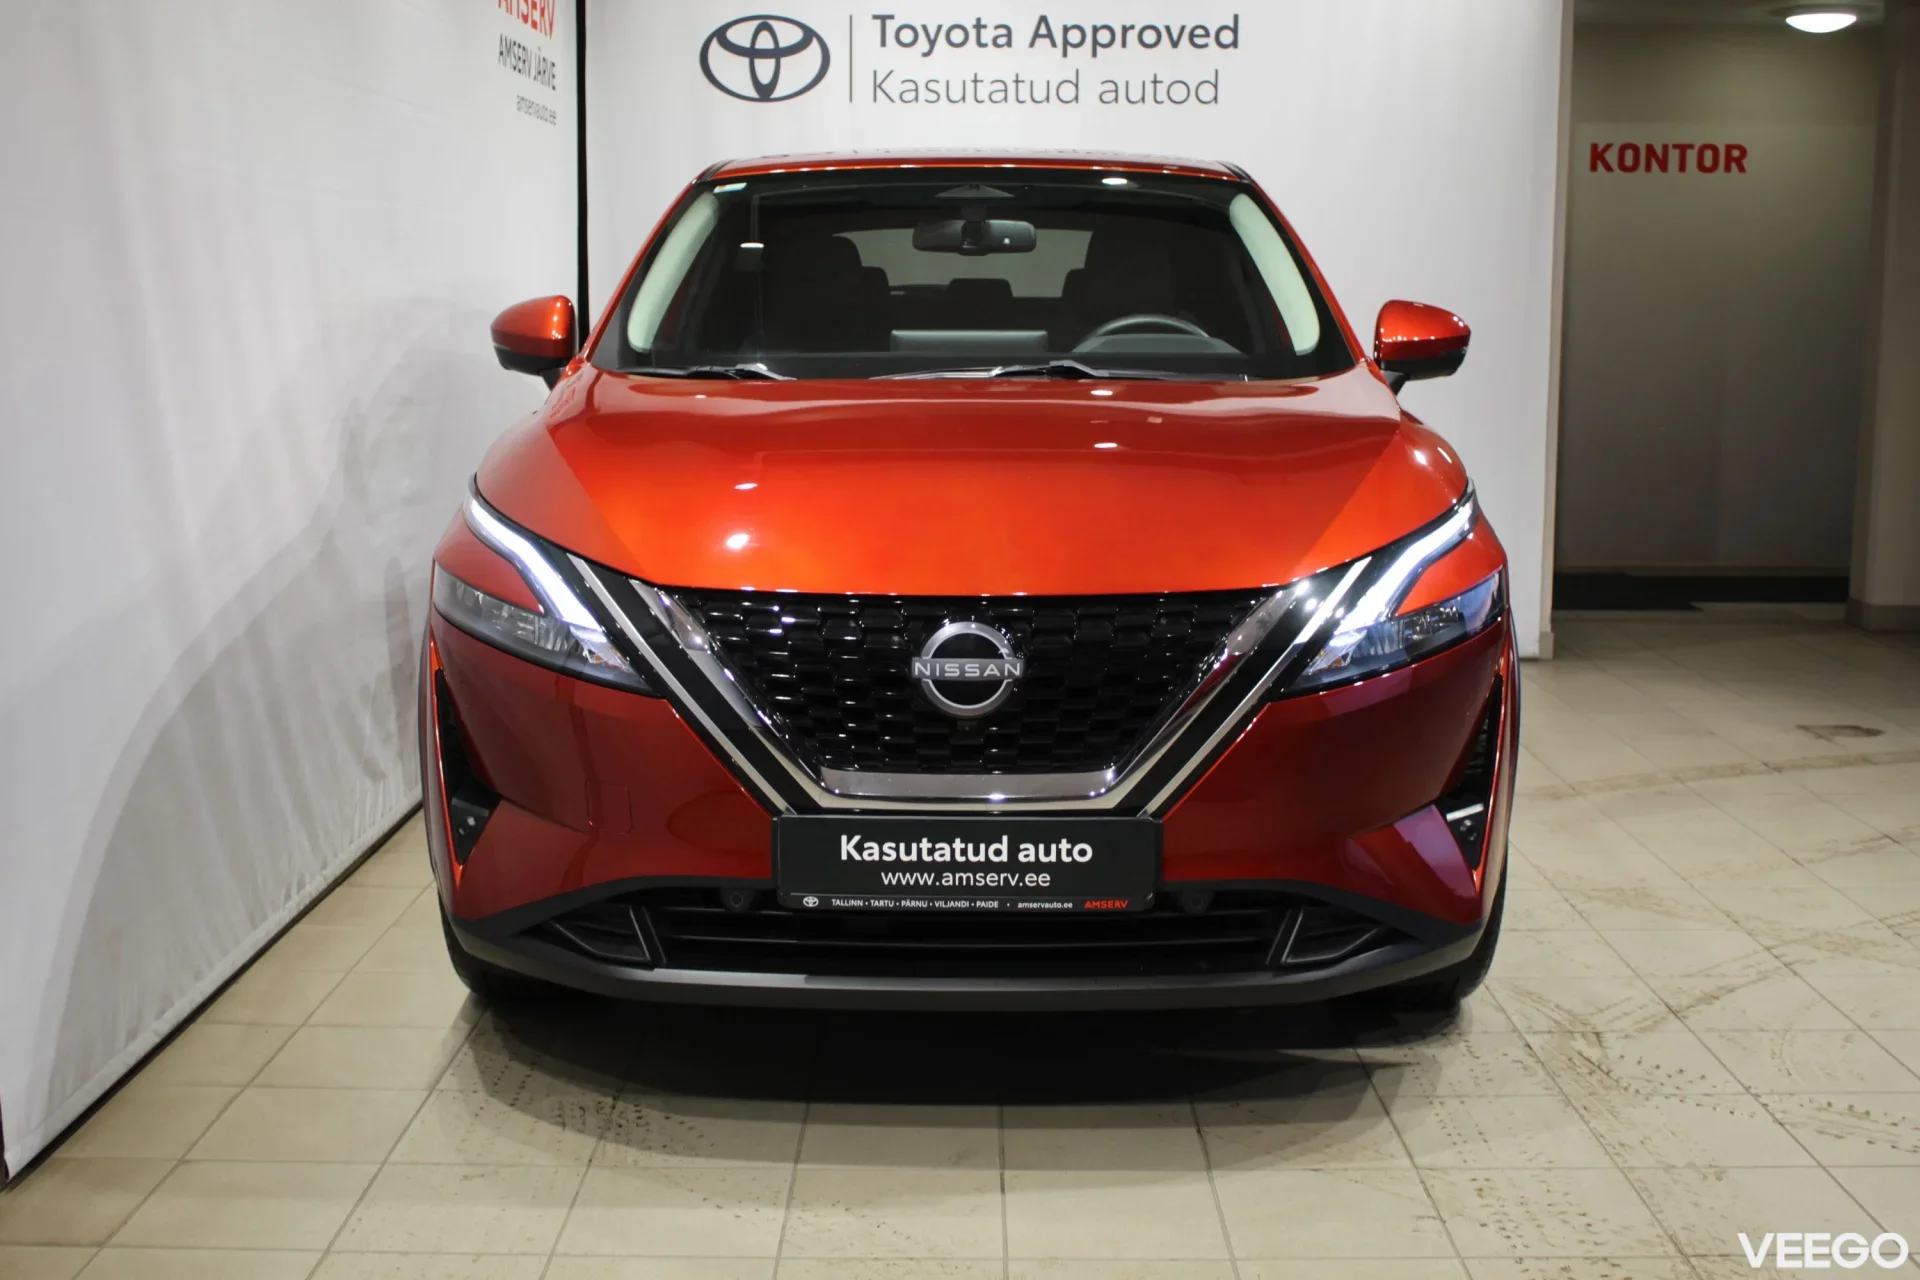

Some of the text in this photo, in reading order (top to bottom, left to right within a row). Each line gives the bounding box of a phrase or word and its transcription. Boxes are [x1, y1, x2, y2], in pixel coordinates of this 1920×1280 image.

[497, 0, 555, 39] SERV
[872, 14, 1239, 56] Toyota Approved
[498, 33, 556, 91] AMSERV JÄRVE
[873, 69, 1219, 104] Kasutatud autod
[1589, 142, 1748, 174] KONTOR
[914, 662, 1021, 677] NISSAN
[840, 835, 1093, 863] Kasutatud auto
[881, 870, 1051, 888] www.amserv.ee
[831, 898, 1128, 910] TALLINN TARTU PÄRNU VILJANDI PAIDE amservauto.ee AMSERV
